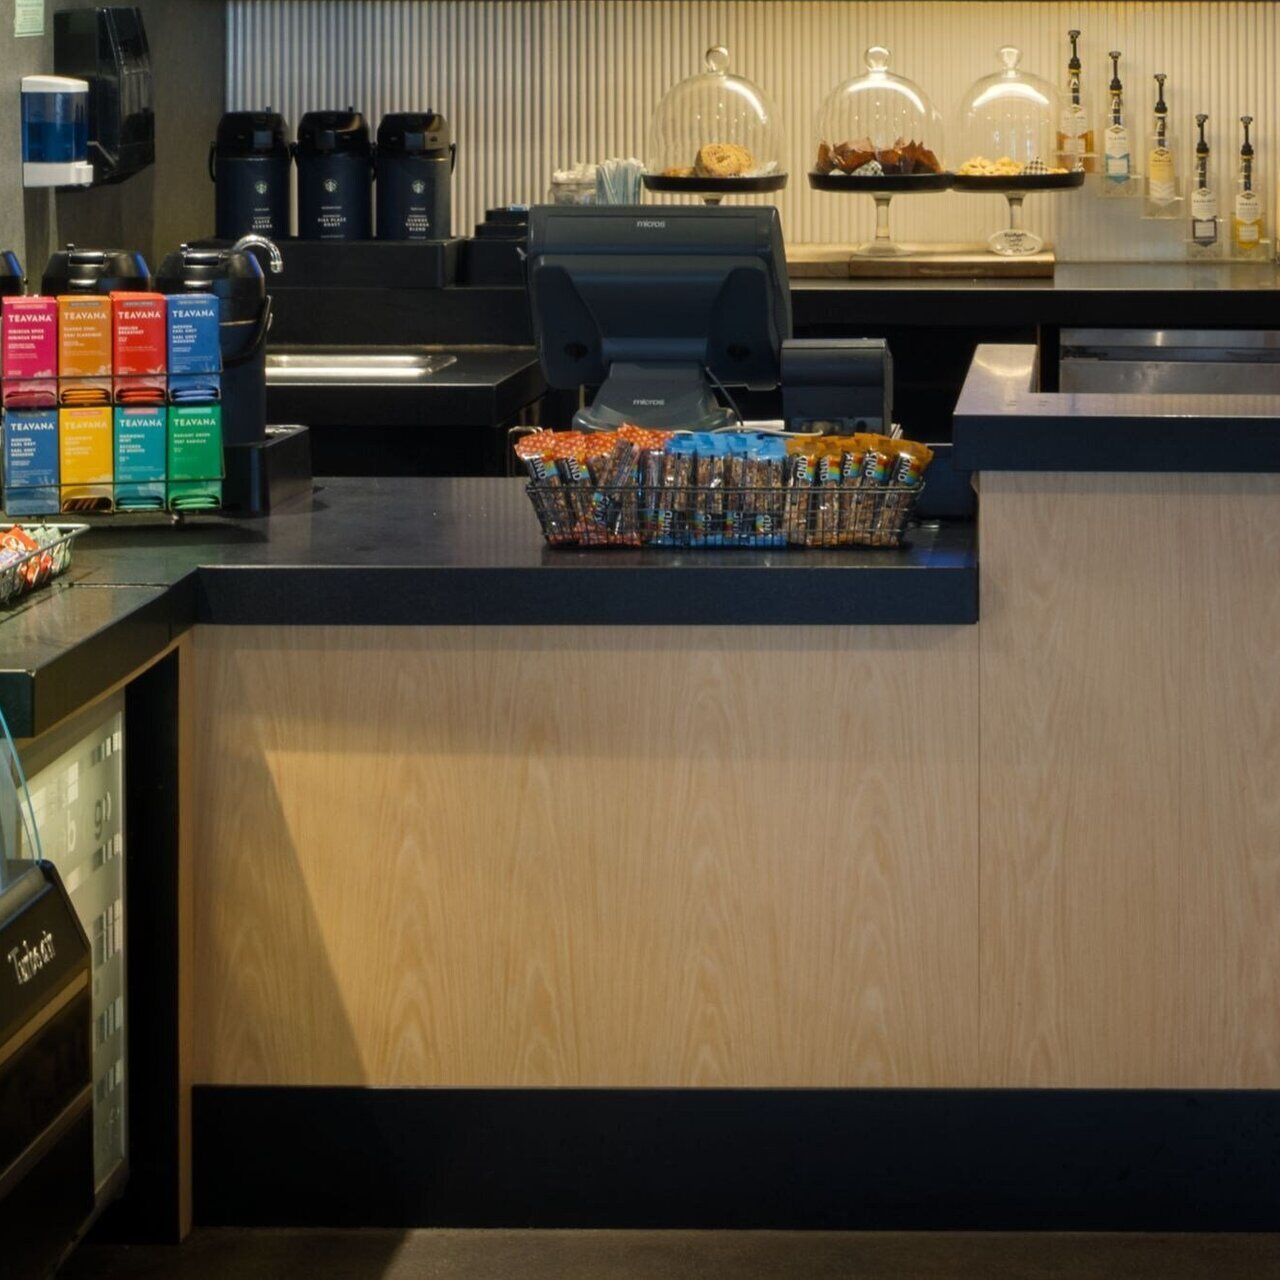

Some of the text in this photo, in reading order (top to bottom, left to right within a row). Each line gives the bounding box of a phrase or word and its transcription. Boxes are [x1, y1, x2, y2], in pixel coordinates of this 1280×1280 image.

[636, 219, 666, 228] micros
[8, 314, 52, 322] TEAVANA
[63, 312, 107, 320] TEAVANA
[118, 311, 161, 319] TEAVANA
[172, 310, 215, 318] TEAVANA
[633, 398, 665, 406] micros
[119, 419, 162, 427] TEAVANA
[173, 418, 216, 426] TEAVANA
[10, 422, 54, 431] TEAVANA
